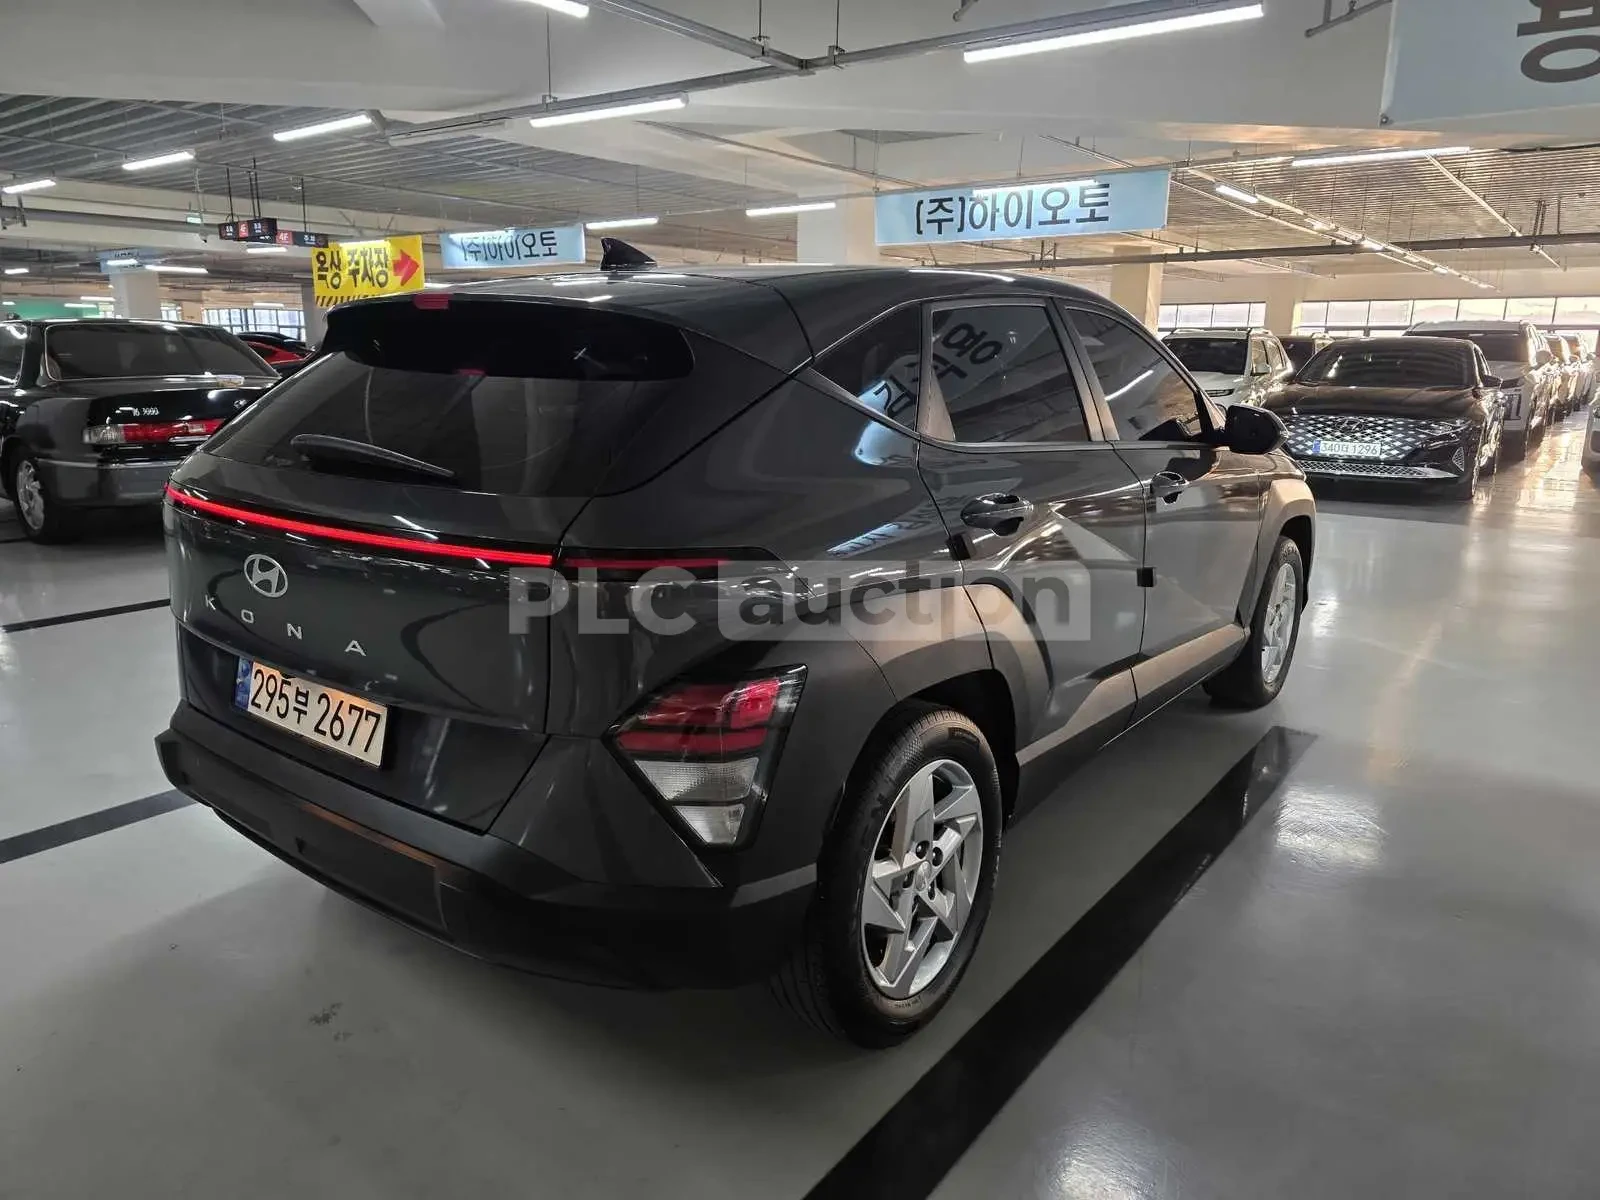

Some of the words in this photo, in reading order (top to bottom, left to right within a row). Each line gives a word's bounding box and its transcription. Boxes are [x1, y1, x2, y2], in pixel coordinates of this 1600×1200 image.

[315, 250, 342, 289] 옥상
[346, 246, 389, 289] 주차장
[204, 594, 367, 657] KONA
[250, 668, 310, 724] 295부
[313, 692, 382, 753] 2677
